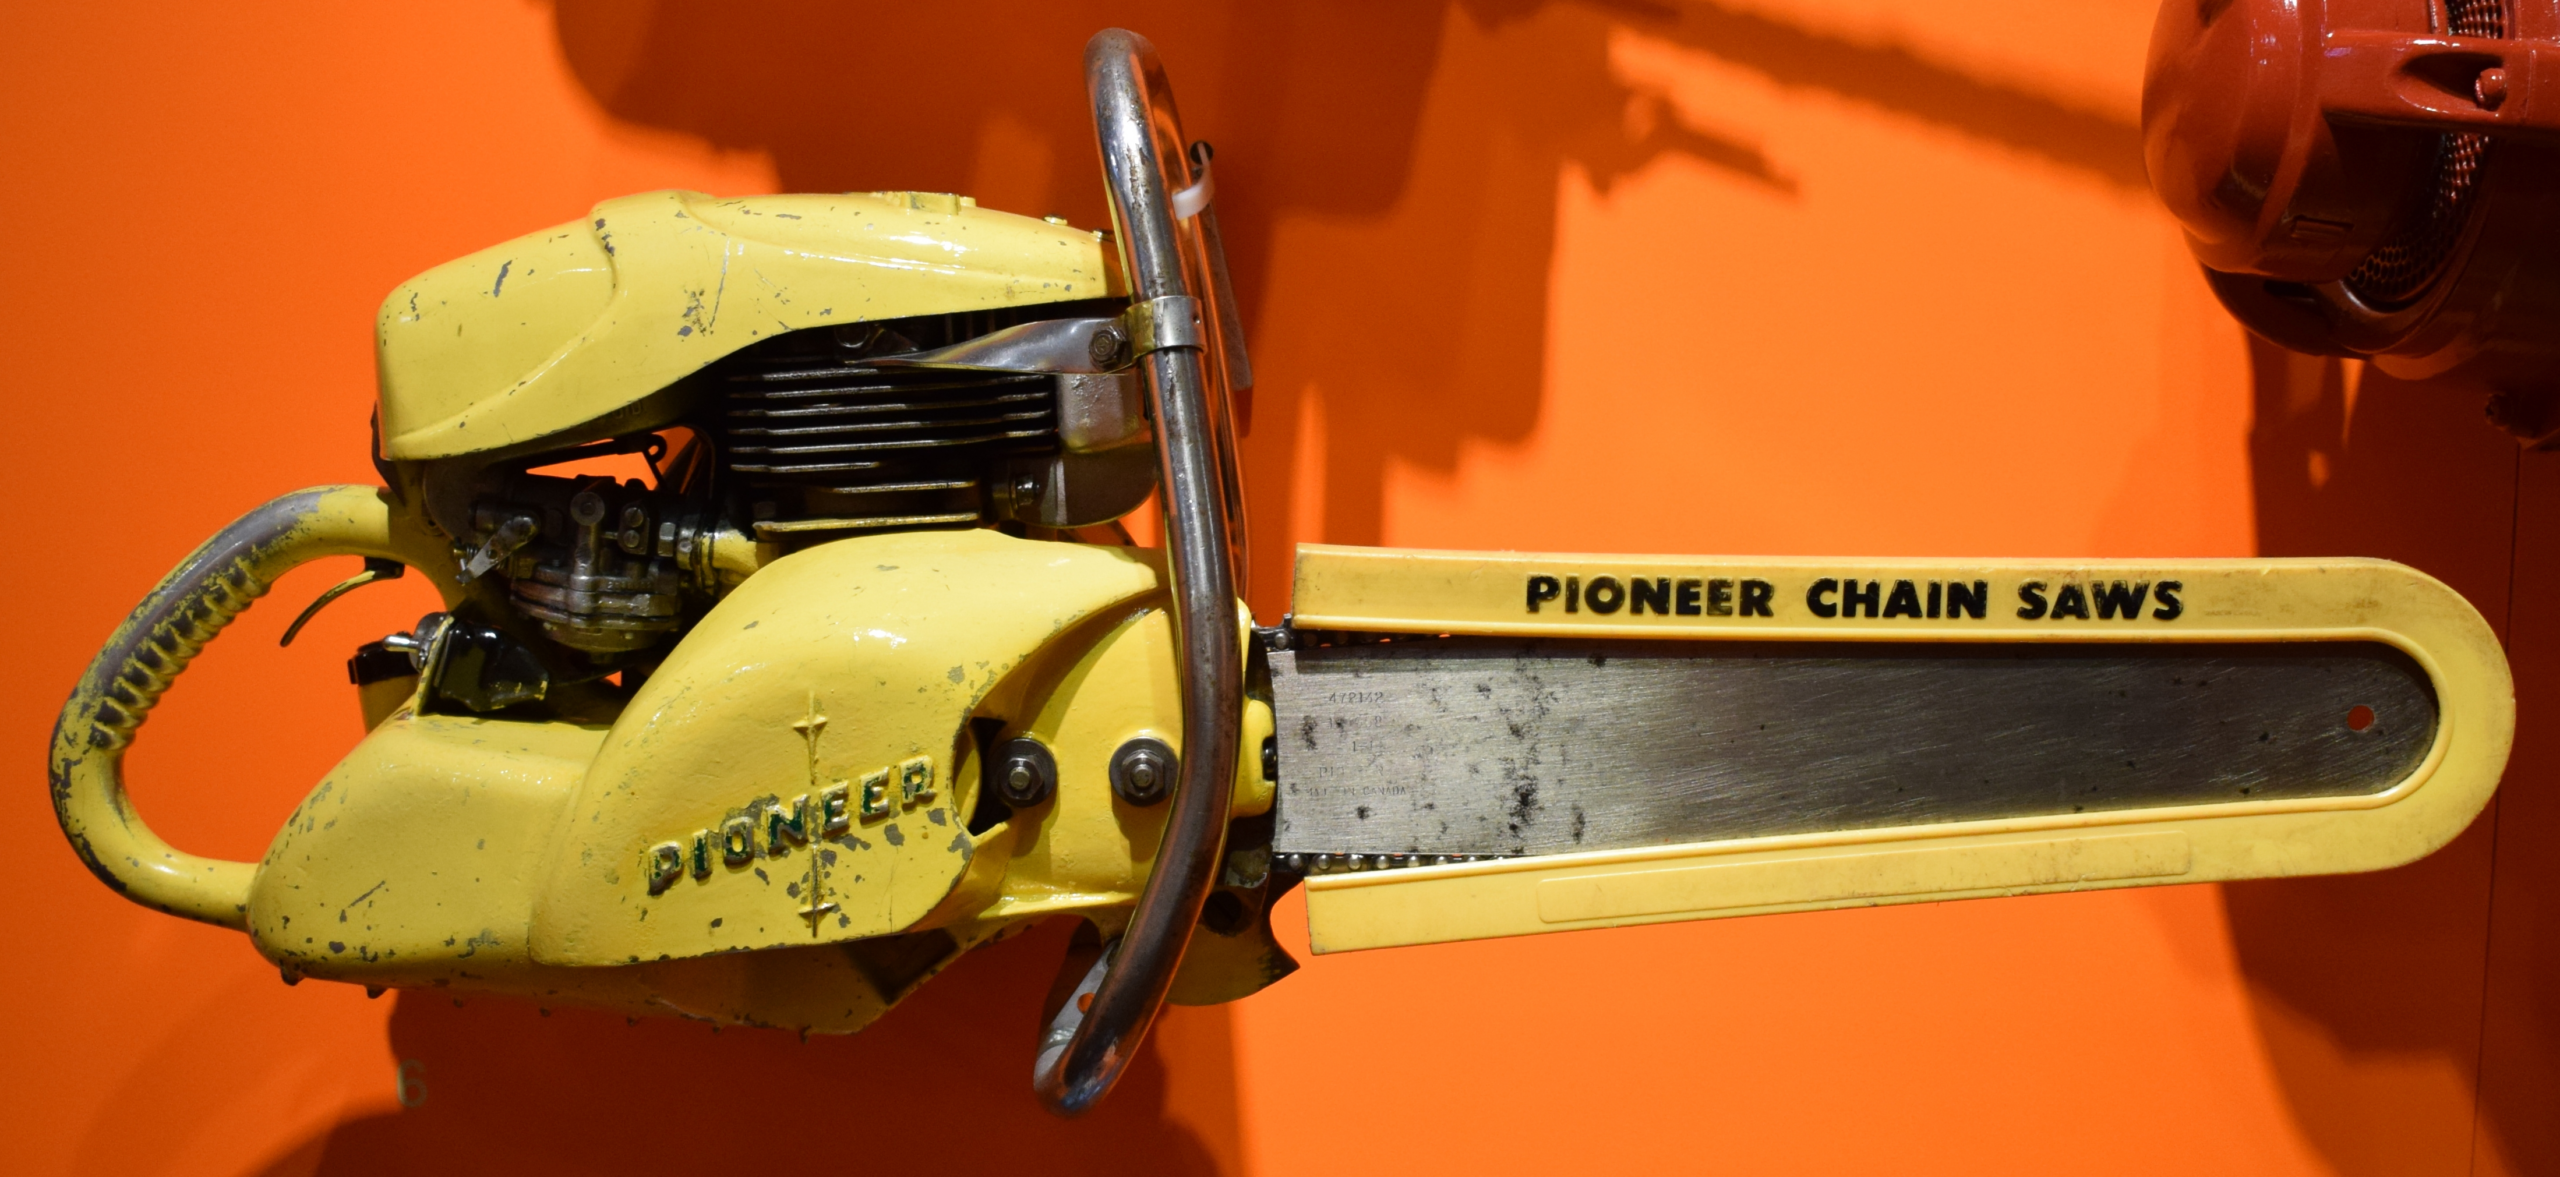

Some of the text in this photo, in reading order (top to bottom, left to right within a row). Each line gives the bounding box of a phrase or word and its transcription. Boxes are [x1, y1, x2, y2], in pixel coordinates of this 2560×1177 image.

[1526, 574, 2185, 622] PIONEER CHAIN SAWS
[1363, 785, 1407, 796] CANADA
[647, 755, 937, 896] PIONEER
[397, 1058, 428, 1109] 6
